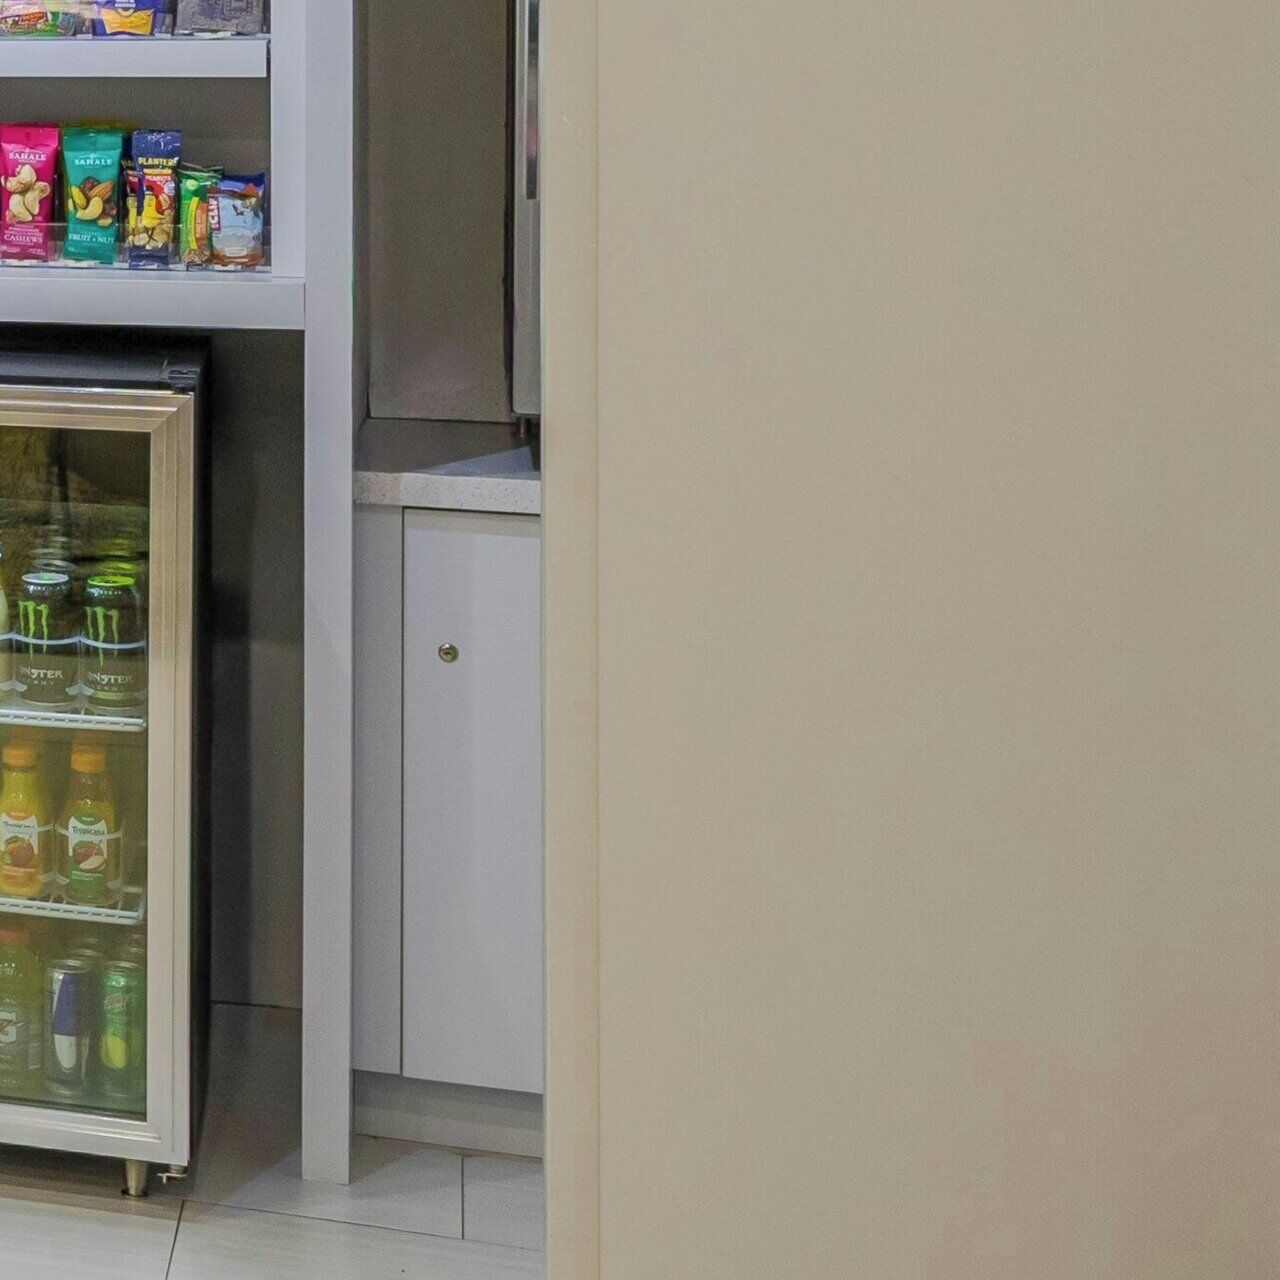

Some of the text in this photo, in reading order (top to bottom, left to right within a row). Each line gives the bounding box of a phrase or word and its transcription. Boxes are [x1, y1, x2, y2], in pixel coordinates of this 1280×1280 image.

[9, 152, 46, 161] SAHALE
[74, 158, 113, 166] SAHALE
[72, 825, 105, 839] Tropicana
